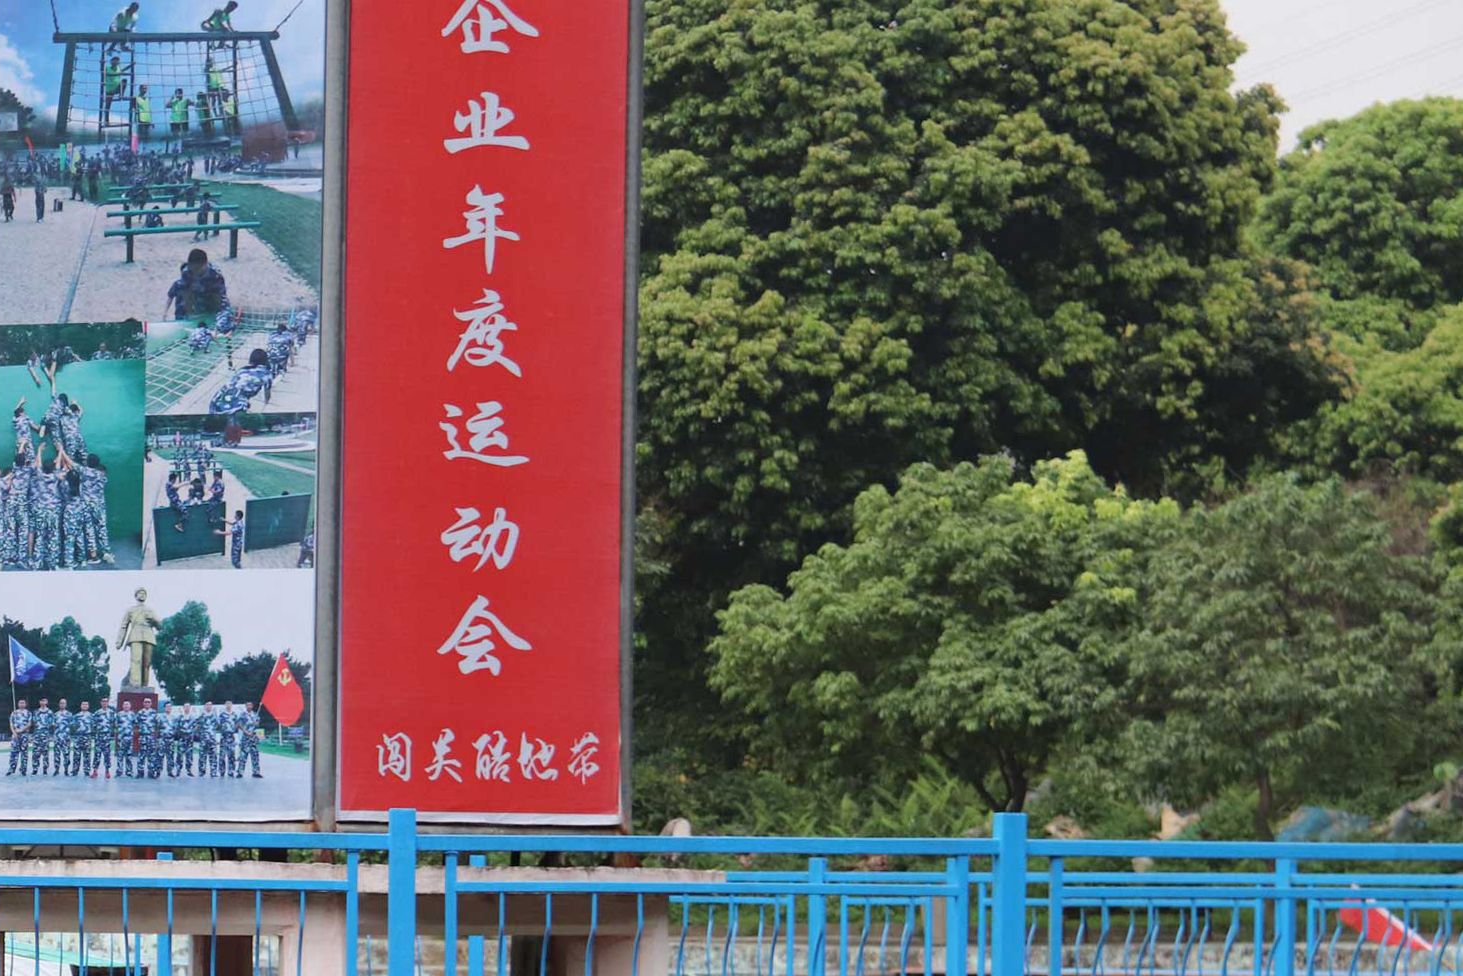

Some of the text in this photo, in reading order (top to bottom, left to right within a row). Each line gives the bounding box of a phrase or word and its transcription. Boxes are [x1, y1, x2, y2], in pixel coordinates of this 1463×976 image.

[438, 0, 540, 676] 企业年度运动会
